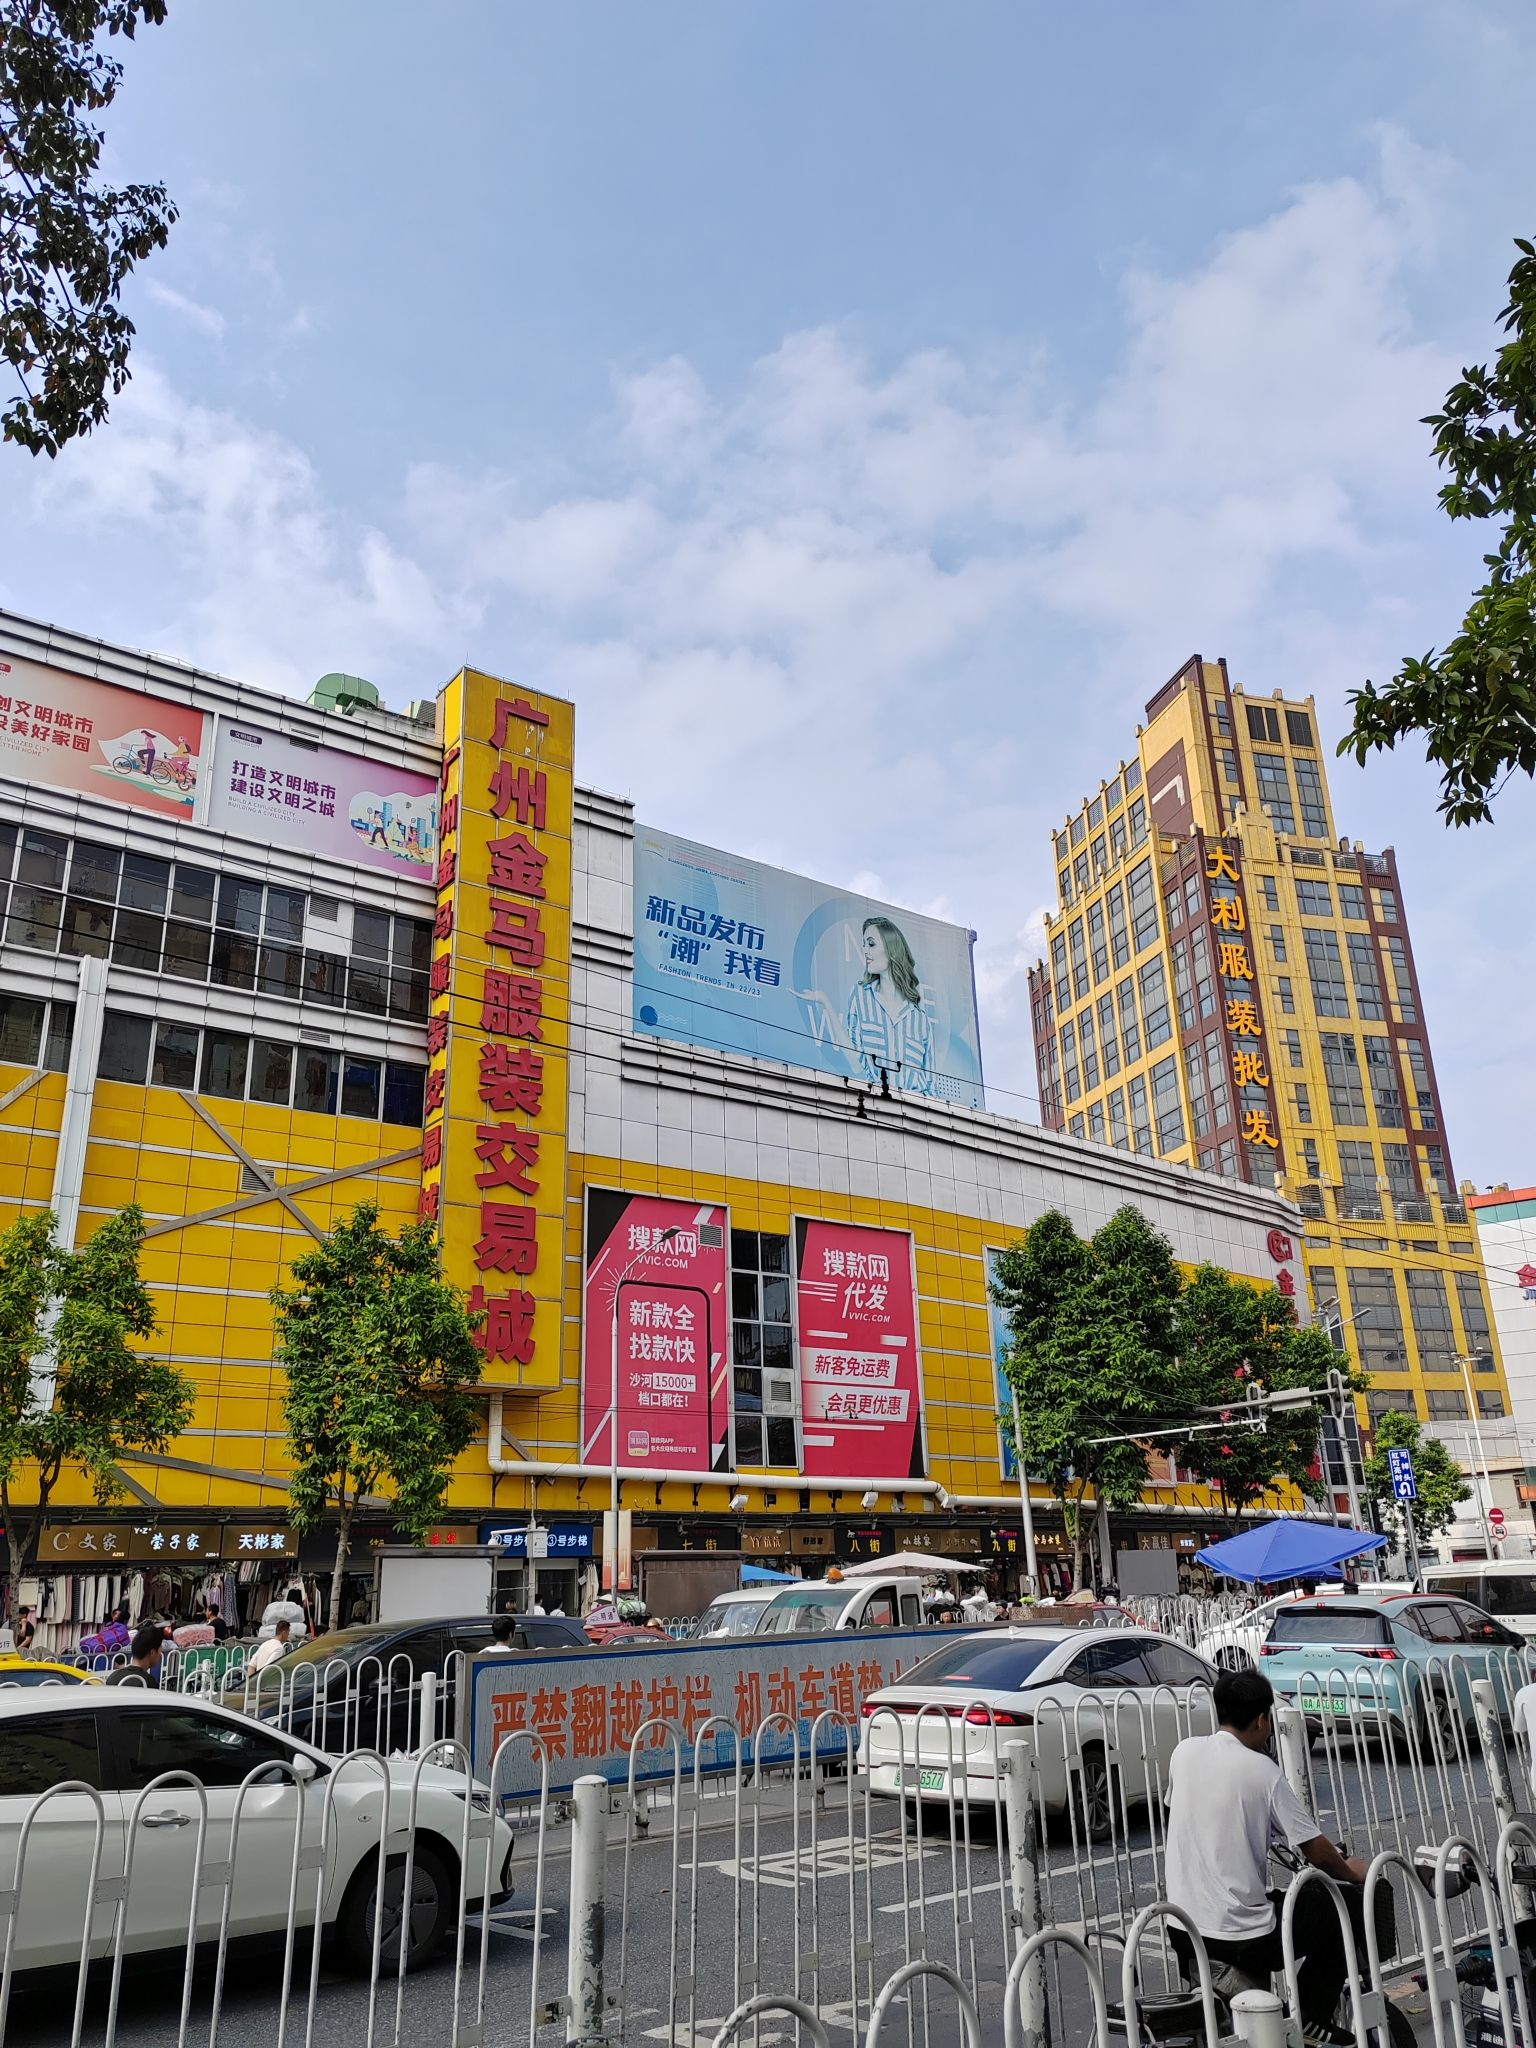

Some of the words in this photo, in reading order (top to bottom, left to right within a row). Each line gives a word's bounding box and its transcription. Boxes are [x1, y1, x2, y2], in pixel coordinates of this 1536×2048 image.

[232, 759, 336, 800] 打造文明城市
[228, 801, 256, 813] BUILDING
[263, 810, 292, 822] CIVILIZED
[229, 795, 247, 805] BUILD
[253, 802, 282, 814] CIVILIZED
[283, 809, 296, 817] CITY
[230, 777, 335, 818] 建设文明之城
[646, 895, 766, 951] 新品发布
[659, 963, 692, 979] FASHION
[695, 973, 722, 986] TRENDS
[726, 981, 736, 990] IN
[739, 984, 762, 996] 22/23
[1205, 846, 1279, 1148] 大利服装批发
[467, 698, 550, 1365] 广州金马服装交易城
[628, 1224, 697, 1258] 搜款网
[637, 1254, 688, 1269] VVIC.COM
[823, 1247, 890, 1282] 搜款网
[629, 1300, 696, 1331] 新款全
[841, 1281, 889, 1319] 代发
[849, 1311, 891, 1324] VVIC.COM
[629, 1332, 696, 1364] 找款快
[815, 1354, 891, 1379] 新客免运费
[827, 1392, 903, 1416] 会员更优惠
[1400, 1451, 1411, 1481] 可掉头
[78, 1532, 118, 1551] 文家
[238, 1533, 286, 1550] 天彬家
[850, 1538, 881, 1553] 八街
[991, 1538, 1017, 1553] 九街
[488, 1674, 715, 1768] 严禁翻越护栏
